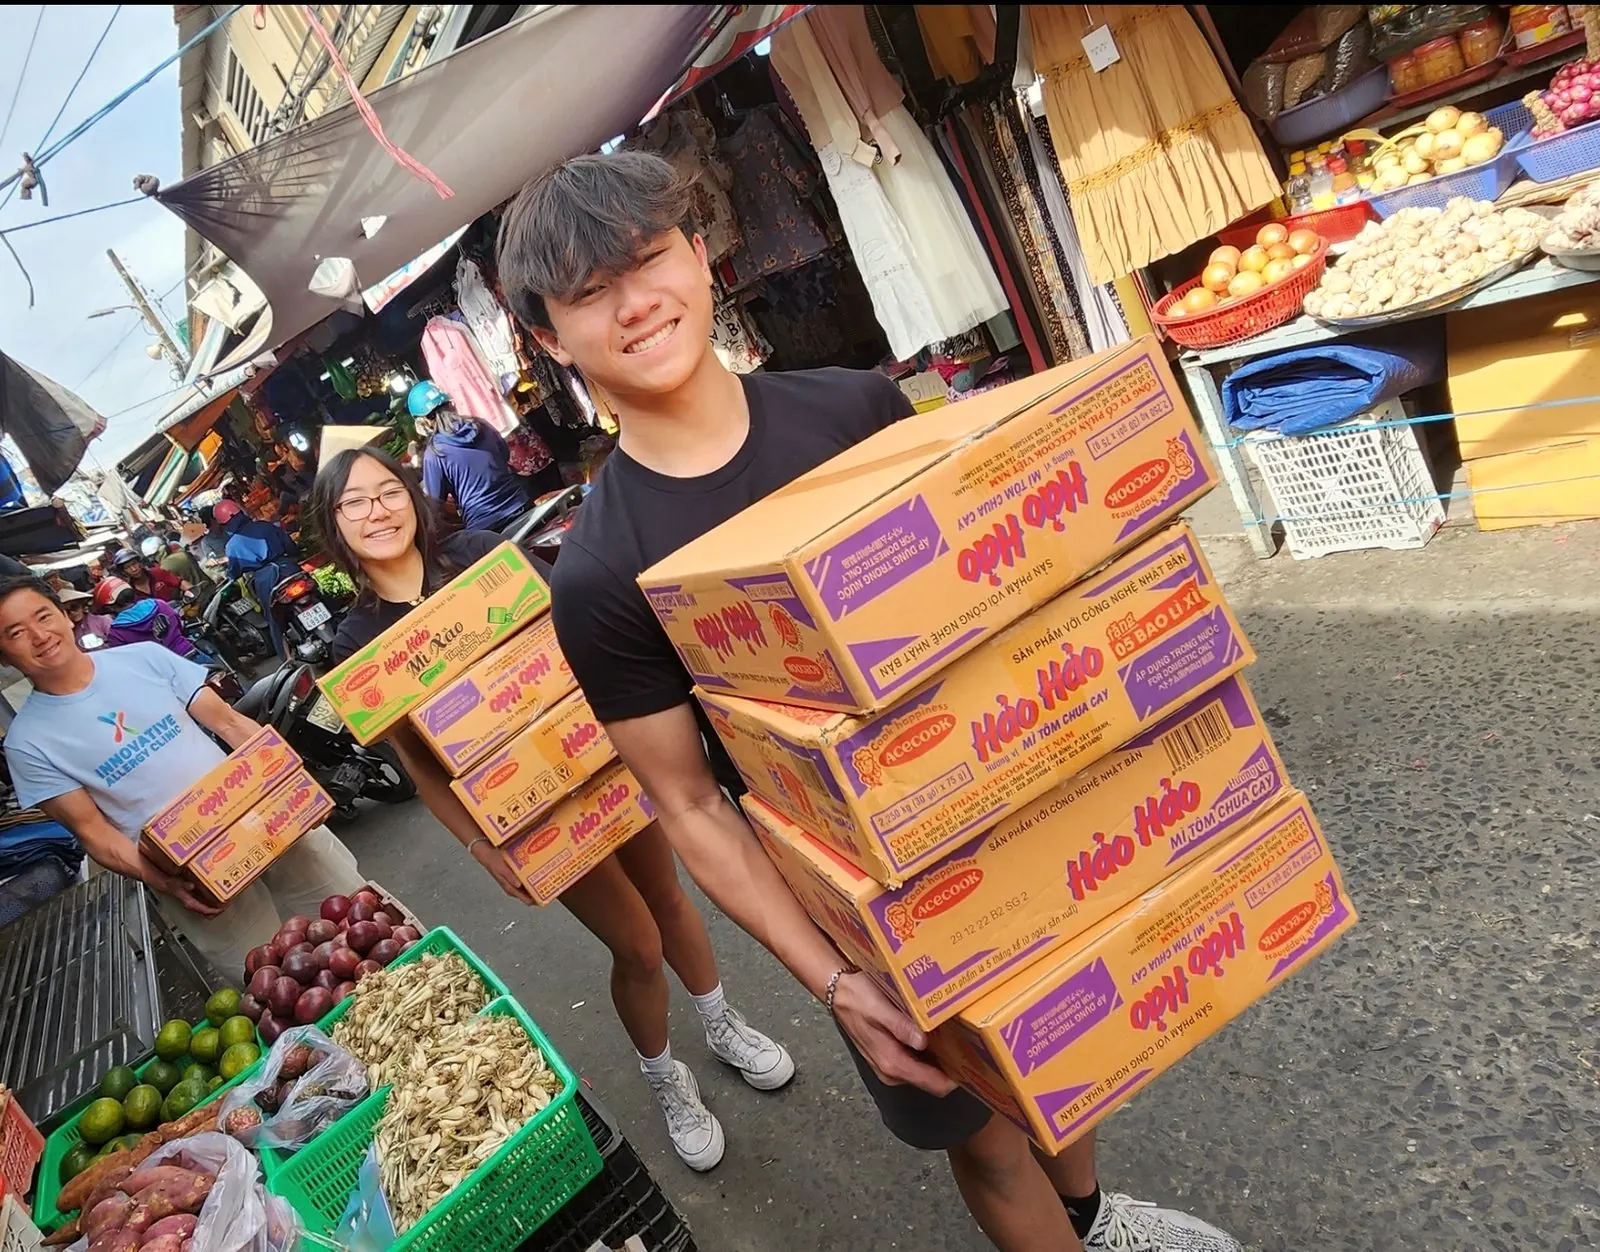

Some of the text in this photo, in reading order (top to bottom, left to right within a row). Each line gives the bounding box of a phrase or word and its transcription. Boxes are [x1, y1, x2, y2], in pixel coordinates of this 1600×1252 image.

[1120, 394, 1131, 406] TY
[1034, 427, 1077, 459] ACECOOK
[989, 470, 1011, 488] NAM
[1004, 479, 1027, 500] TÔM
[1028, 469, 1041, 486] MÌ
[1111, 476, 1177, 519] Cook happiness
[957, 461, 1089, 588] Hảo Hảo
[958, 511, 976, 531] CAY
[977, 494, 1003, 517] CHUA
[841, 532, 916, 584] FOR DOMESTIC ONLY
[862, 561, 894, 584] TRONG
[693, 600, 768, 663] Hảo Hảo
[879, 559, 1053, 678] SẢN PHẨM VỚI CÔNG NGHỆ NHẬT BẢN
[1012, 553, 1187, 664] SẢN PHẨM VỚI CÔNG NGHỆ NHẬT BẢN
[1115, 588, 1201, 656] 05 BAO LÌ XÌ
[386, 631, 430, 672] Hảo Hảo
[1147, 638, 1215, 686] FOR DOMESTIC ONLY
[1170, 638, 1198, 659] TRONG
[969, 641, 1103, 763] Hảo Hảo
[1022, 732, 1036, 750] MÌ
[1038, 719, 1061, 739] TÔM
[1062, 702, 1089, 725] CHUA
[1090, 688, 1108, 707] CAY
[93, 714, 176, 779] INNOVATIVE
[562, 721, 602, 757] Hảo
[871, 704, 948, 751] Cook happiness
[106, 725, 181, 787] ALLERGY CLINIC
[900, 804, 912, 813] kg
[946, 775, 957, 787] 75
[920, 818, 932, 831] TY
[982, 760, 1028, 794] ACECOOK
[1052, 730, 1075, 749] NAM
[988, 747, 1143, 851] SẢN PHẨM VỚI CÔNG NGHỆ NHẬT BẢN
[569, 783, 631, 845] Hảo Hảo
[1170, 774, 1277, 849] MÌ TÔM CHUA CAY
[1066, 777, 1200, 902] Hảo Hảo
[904, 857, 977, 905] Cook happiness
[964, 924, 976, 935] 12
[975, 915, 990, 930] 22
[989, 905, 1005, 921] B2
[1005, 897, 1021, 911] SG
[1020, 891, 1029, 901] 2
[1130, 911, 1246, 1032] Hảo Hảo
[1264, 935, 1306, 960] happiness
[1060, 1002, 1213, 1122] SẢN PHẨM VỚI CÔNG NGHỆ NHẬT BẢN
